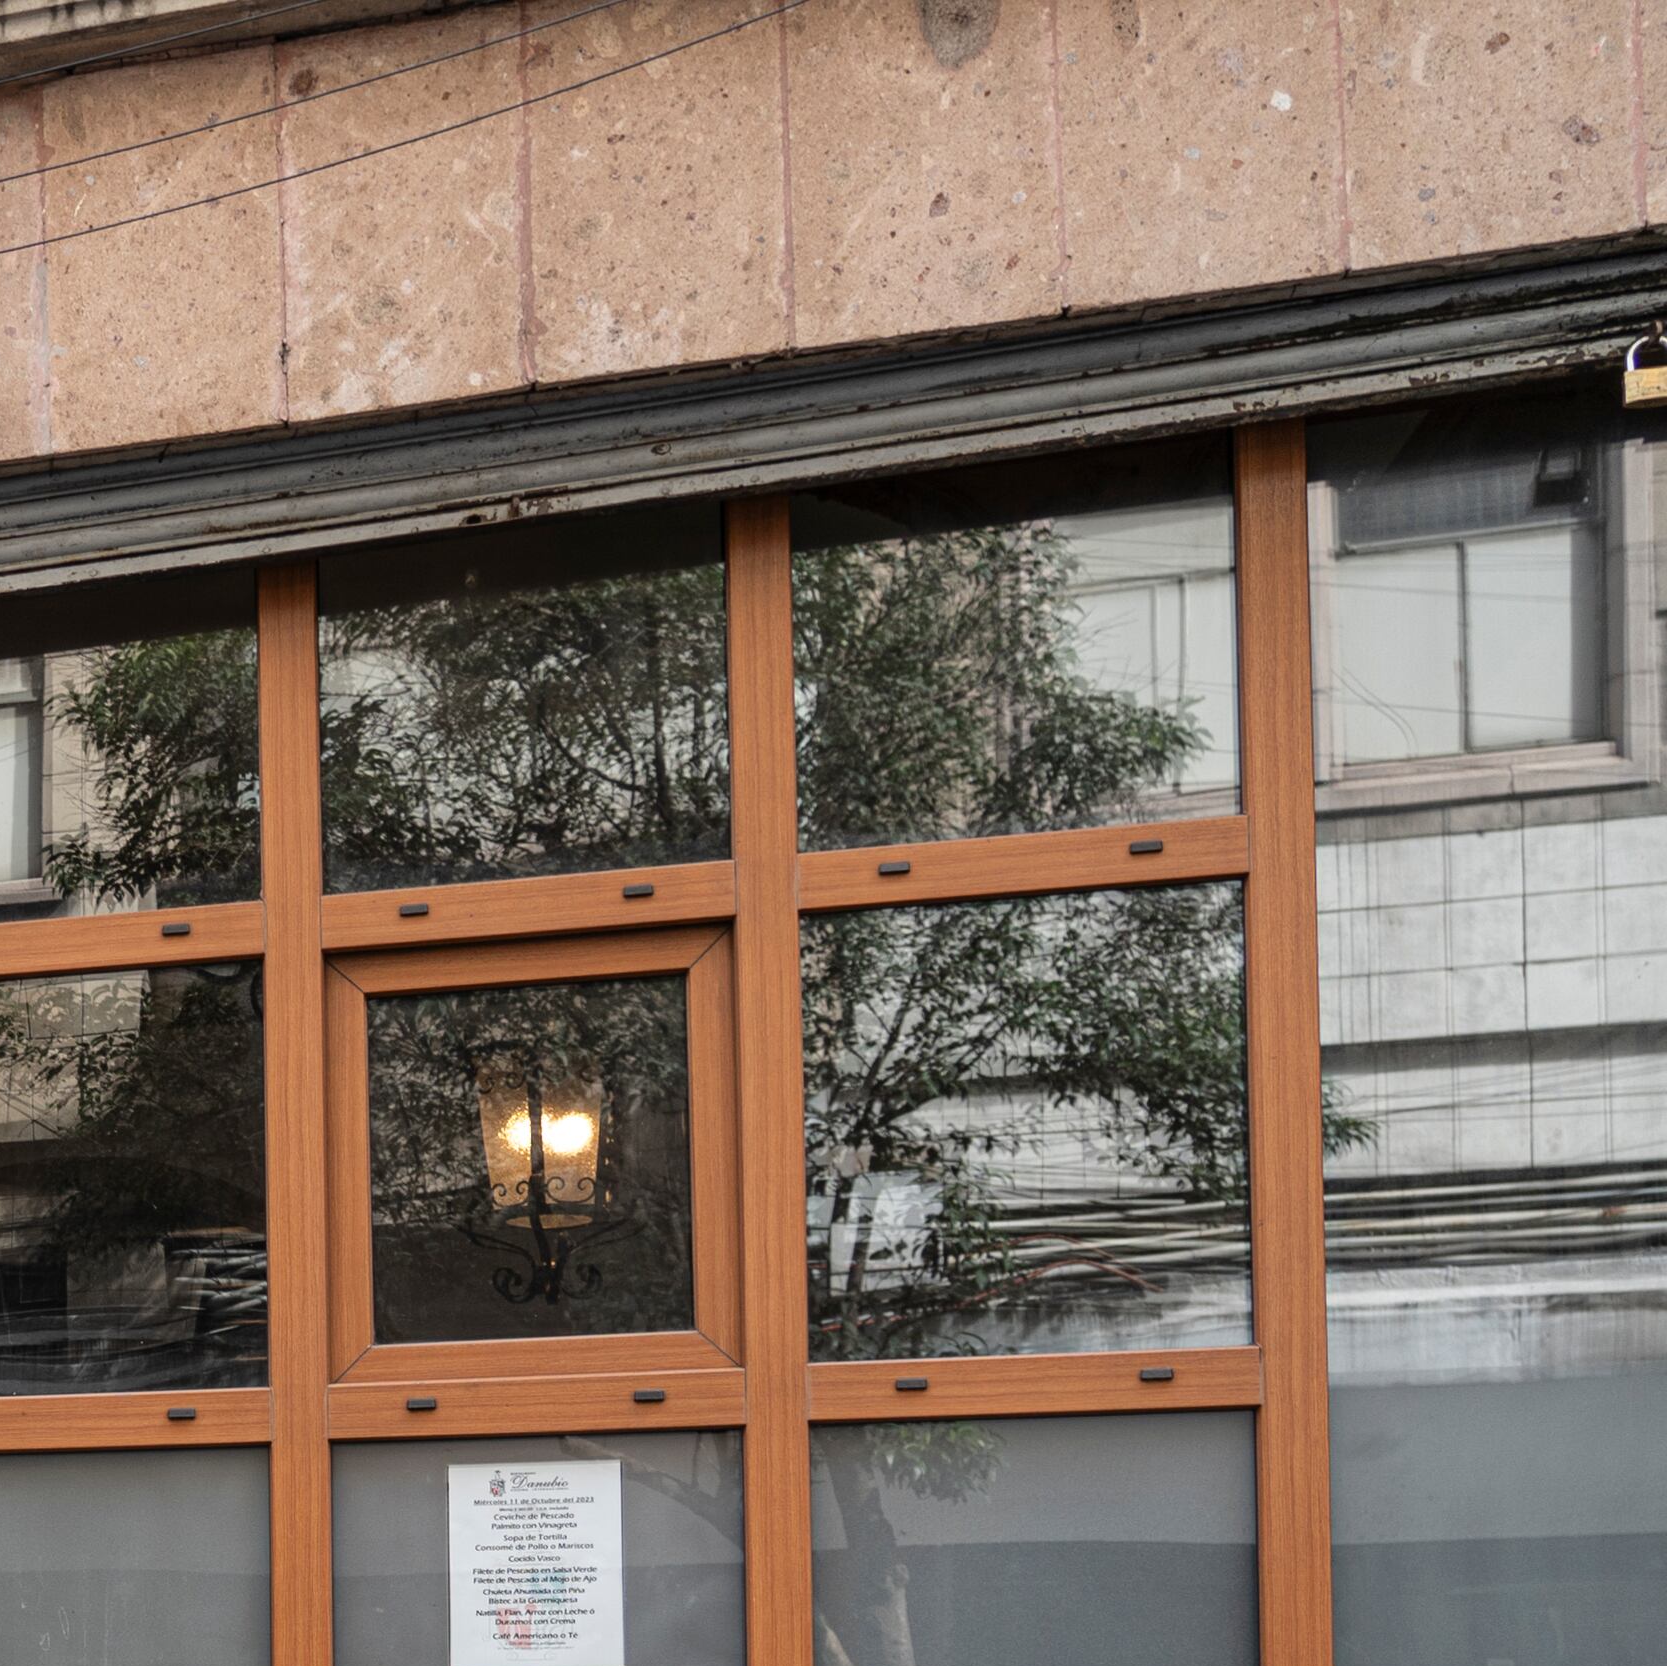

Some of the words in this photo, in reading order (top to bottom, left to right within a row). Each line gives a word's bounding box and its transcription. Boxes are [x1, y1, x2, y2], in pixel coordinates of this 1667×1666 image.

[510, 1474, 569, 1488] Danubio
[503, 1534, 524, 1542] Sopa
[538, 1533, 567, 1541] Tortilla
[550, 1576, 570, 1584] Mojo
[584, 1575, 597, 1583] Ajo
[492, 1632, 511, 1640] Café
[513, 1632, 559, 1640] Americano
